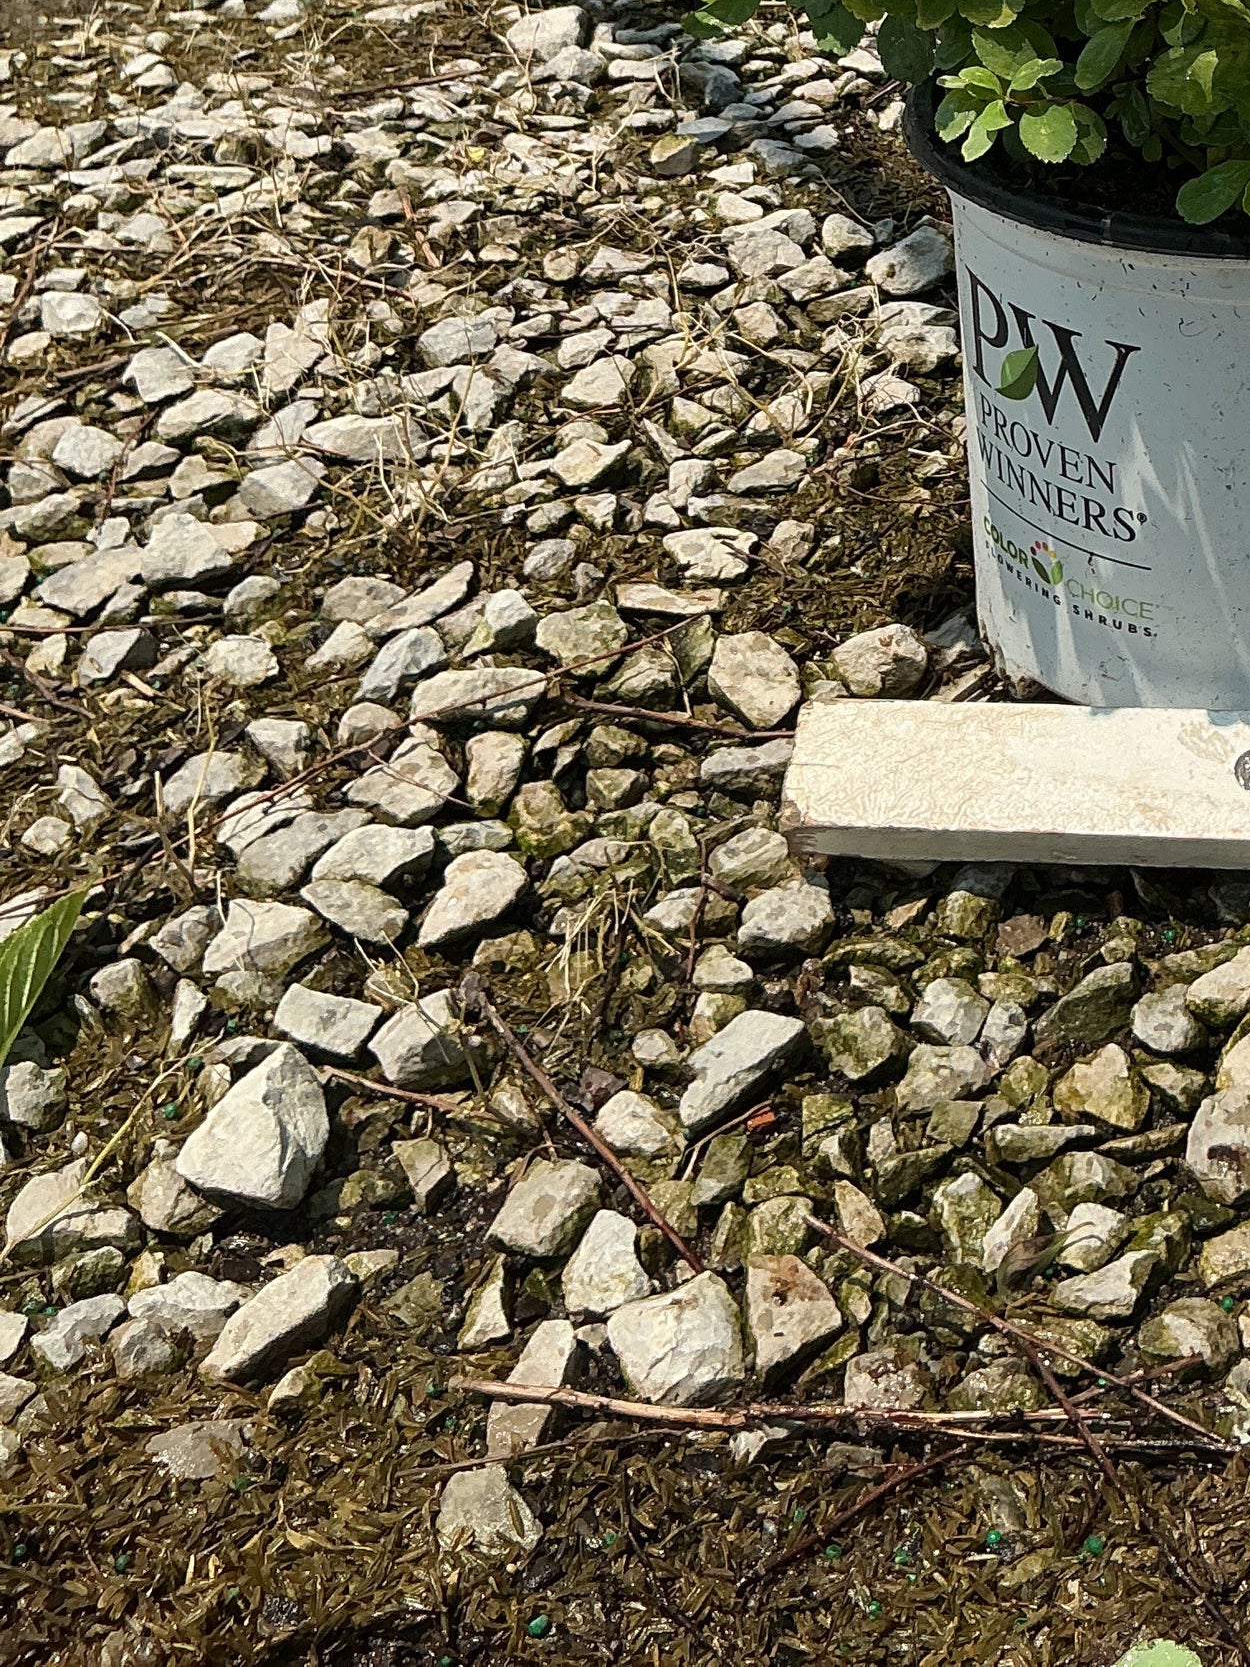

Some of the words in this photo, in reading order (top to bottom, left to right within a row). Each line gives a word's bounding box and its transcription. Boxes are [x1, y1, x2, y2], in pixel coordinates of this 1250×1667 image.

[980, 392, 1118, 495] PROVEN
[984, 515, 1030, 570] COLOR
[1065, 577, 1154, 621] CHOICE
